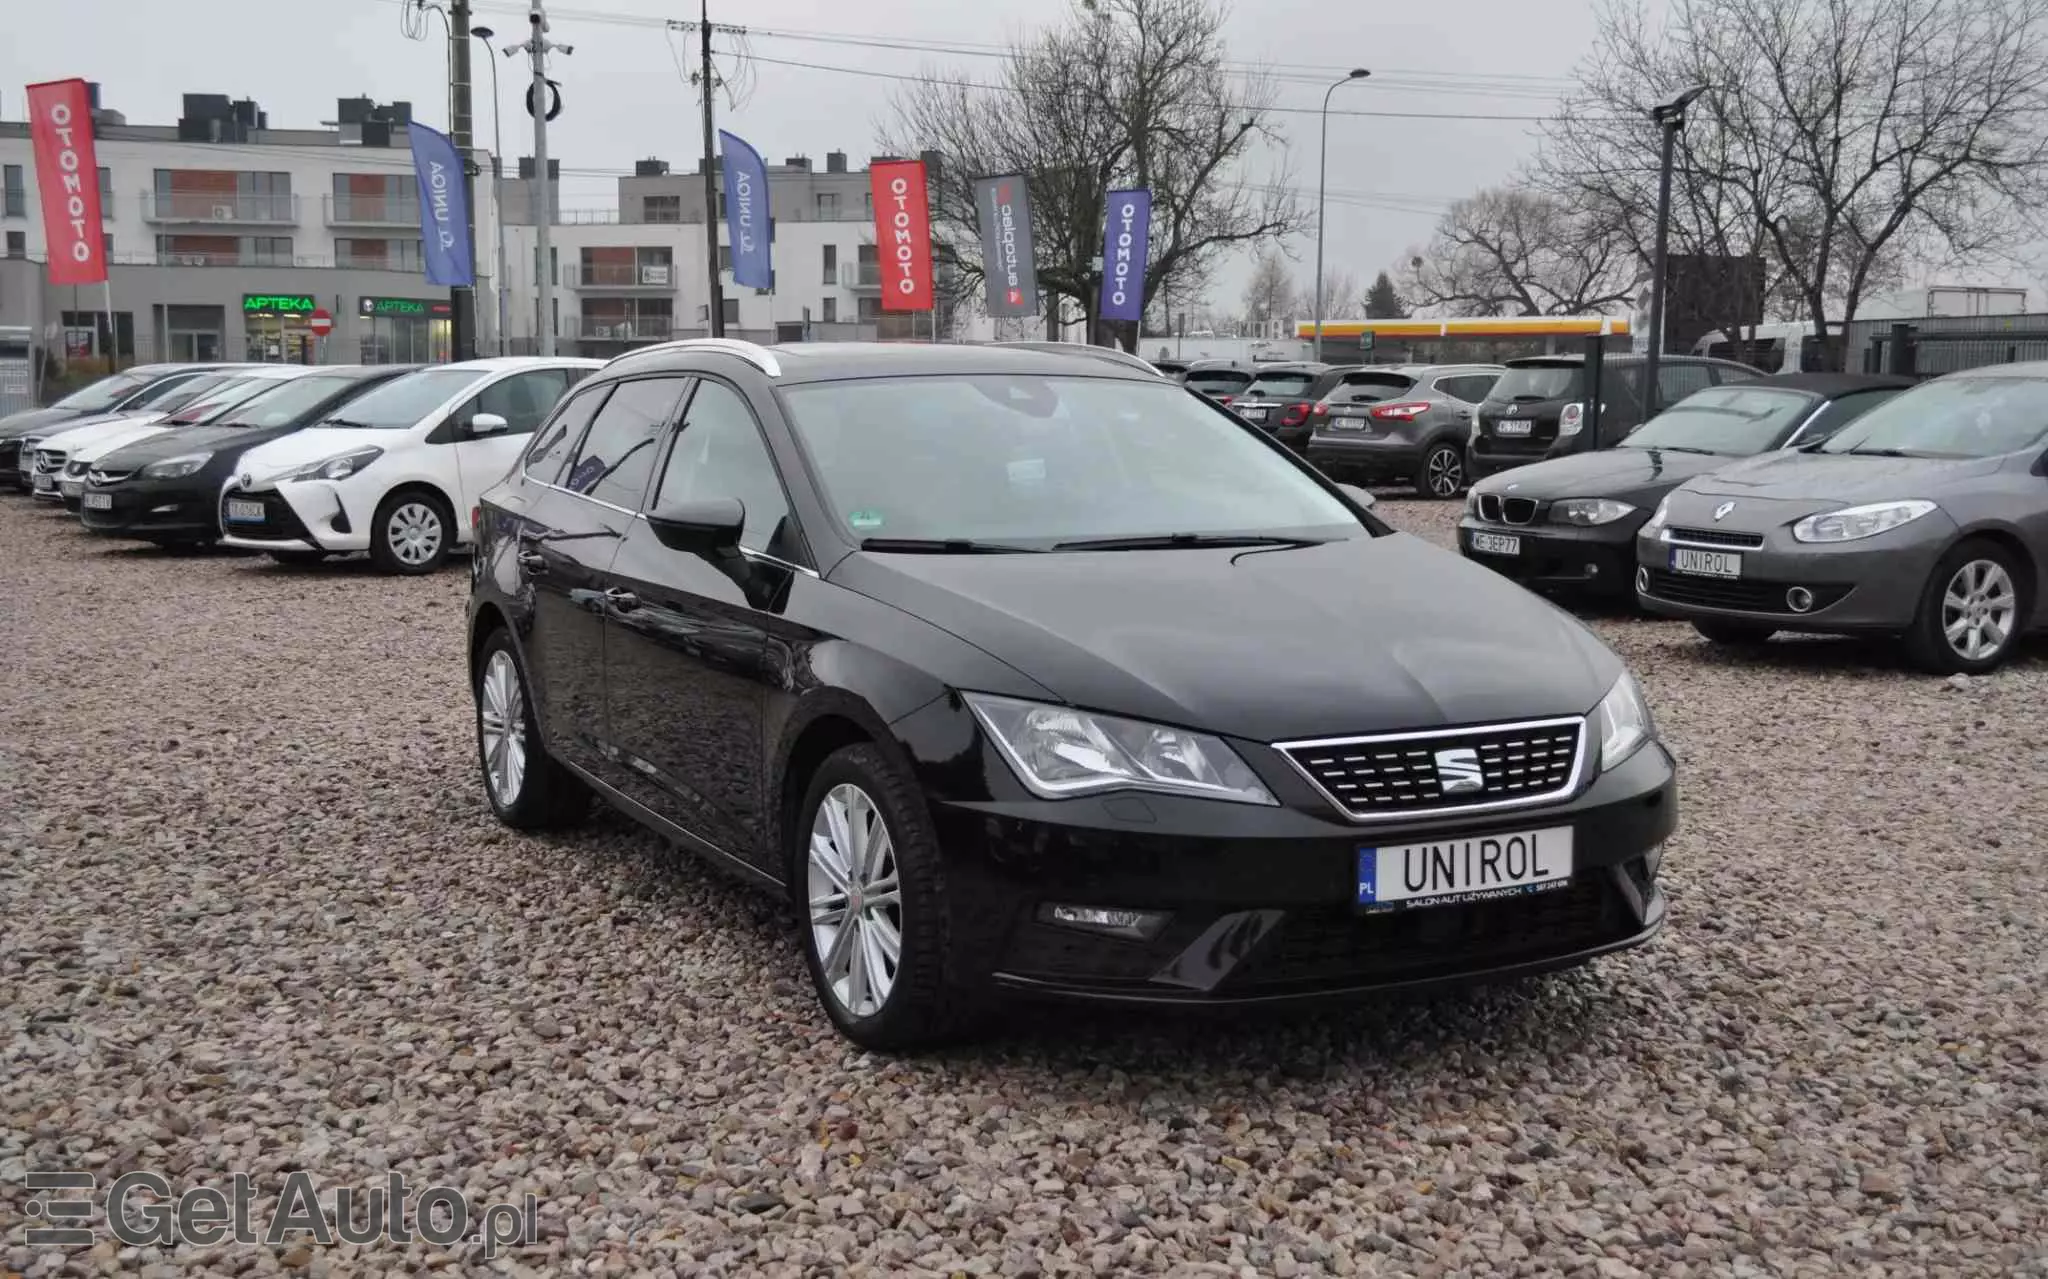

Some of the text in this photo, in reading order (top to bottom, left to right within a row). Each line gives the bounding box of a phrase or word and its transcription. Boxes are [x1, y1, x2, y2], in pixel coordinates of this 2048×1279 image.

[51, 103, 90, 262] OTOMOTO
[891, 178, 915, 295] OTOMOTO
[1112, 203, 1135, 306] OTOMOTO
[244, 297, 314, 311] APTEKA
[375, 300, 425, 313] APTEKA
[1681, 550, 1733, 573] UNIROL
[1403, 833, 1549, 893] UNIROL
[1359, 881, 1375, 896] PL
[1406, 896, 1440, 909] SALON
[1441, 893, 1461, 904] AUT
